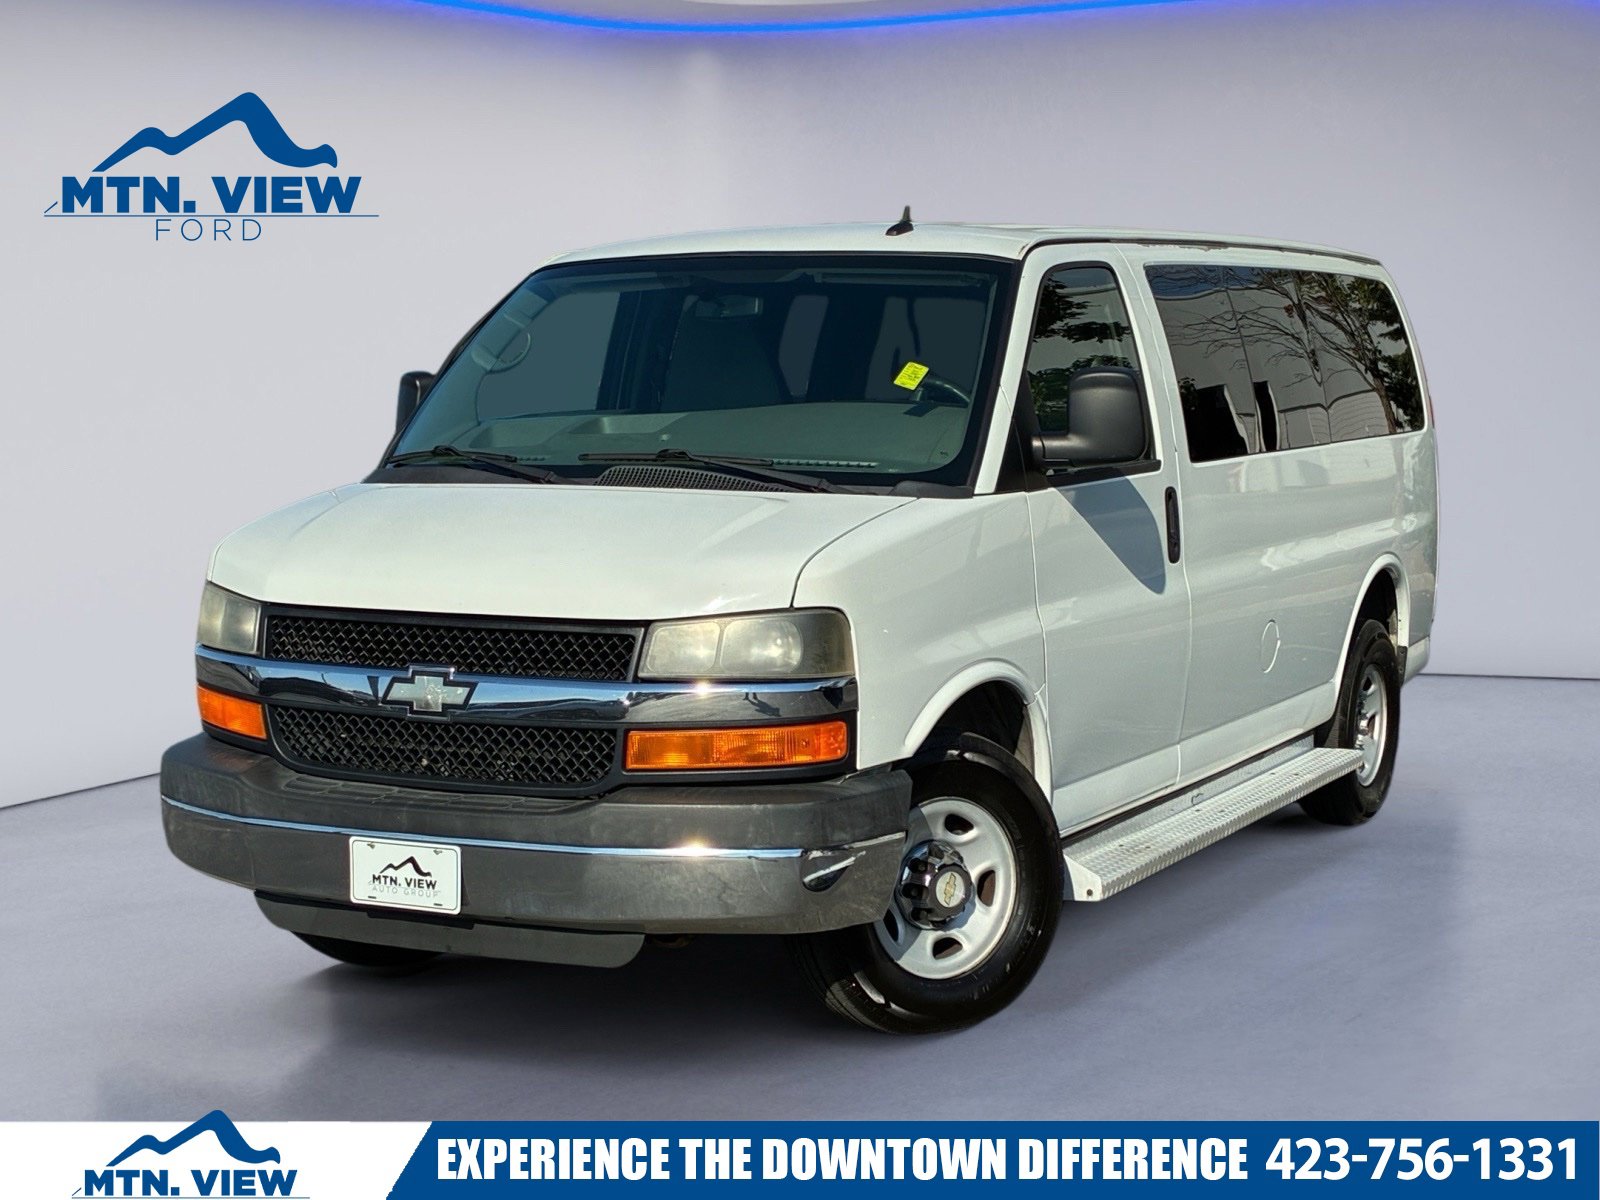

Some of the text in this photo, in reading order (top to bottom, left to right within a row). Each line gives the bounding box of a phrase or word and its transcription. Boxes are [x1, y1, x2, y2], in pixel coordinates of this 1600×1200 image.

[372, 874, 437, 890] MTN. VIEW
[372, 885, 438, 898] AUTO GROUP
